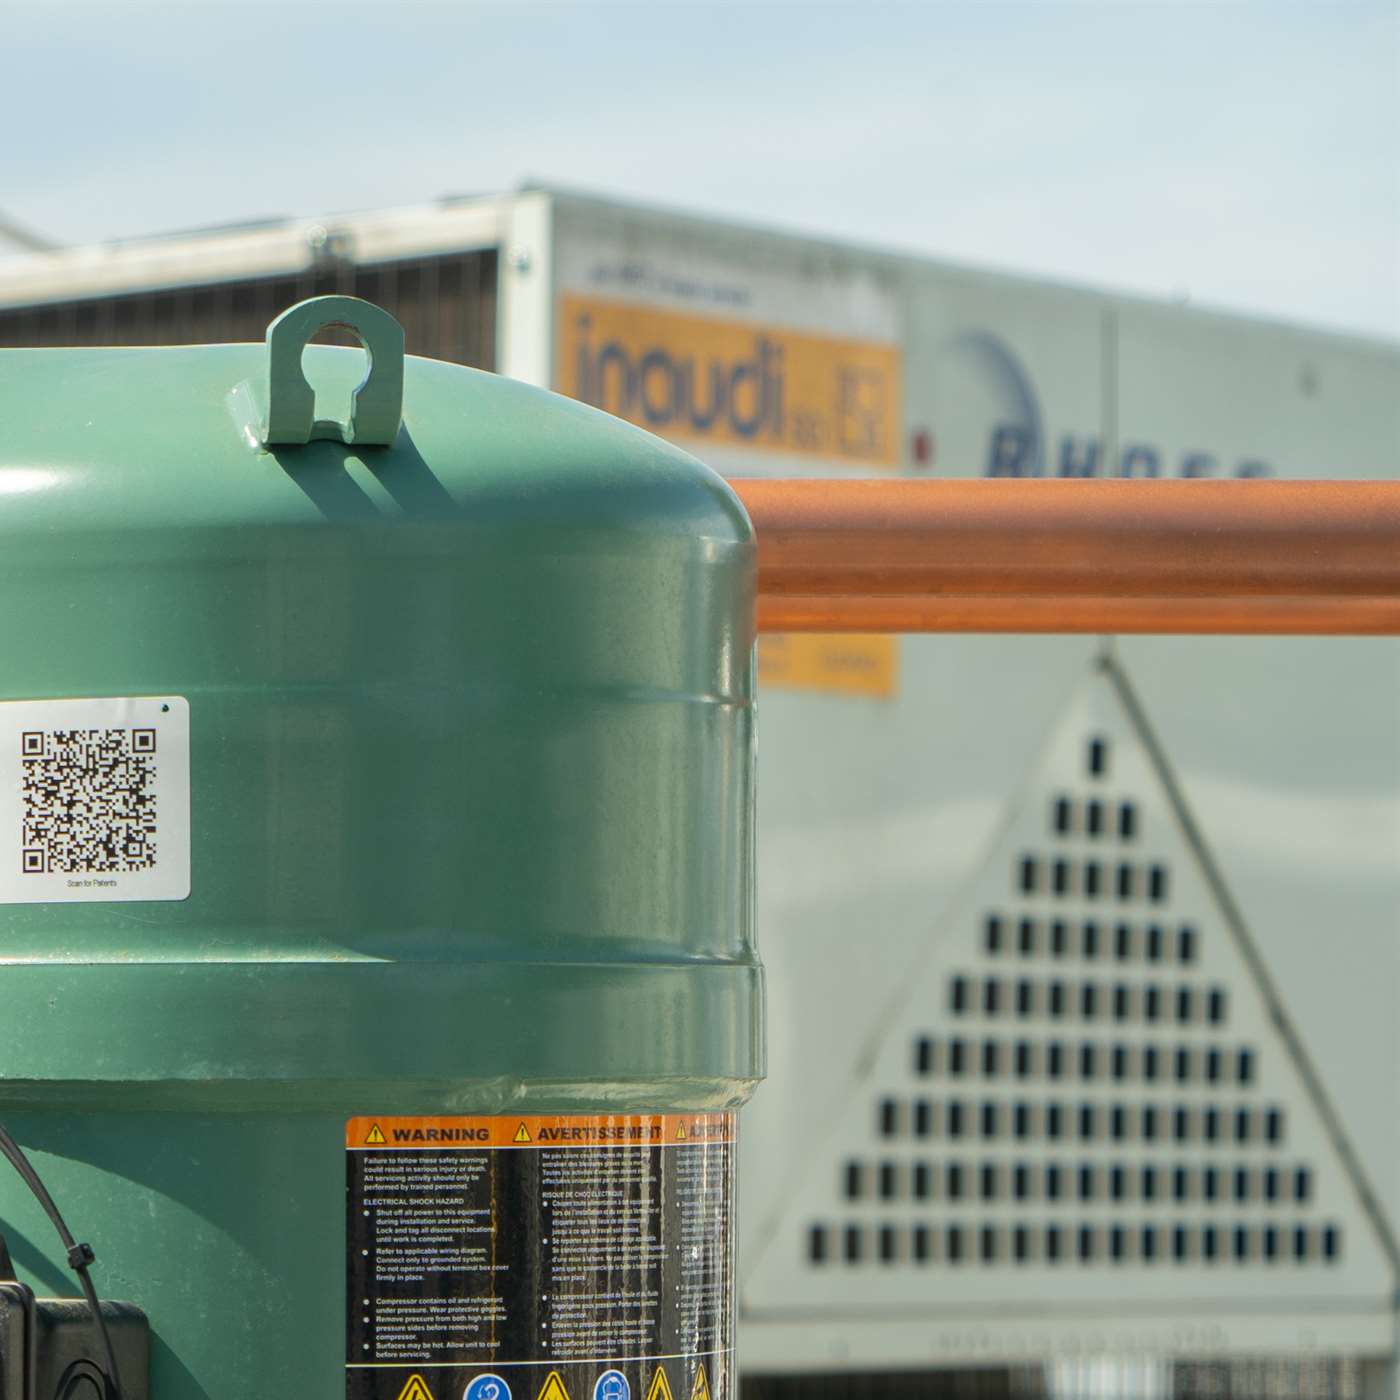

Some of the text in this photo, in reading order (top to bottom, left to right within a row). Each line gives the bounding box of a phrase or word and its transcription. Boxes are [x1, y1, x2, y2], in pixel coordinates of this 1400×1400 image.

[392, 1128, 490, 1142] WARNING
[537, 1126, 663, 1141] AVERTISSEMENT
[364, 1198, 408, 1206] ELECTRICAL
[409, 1198, 435, 1206] SHOCK
